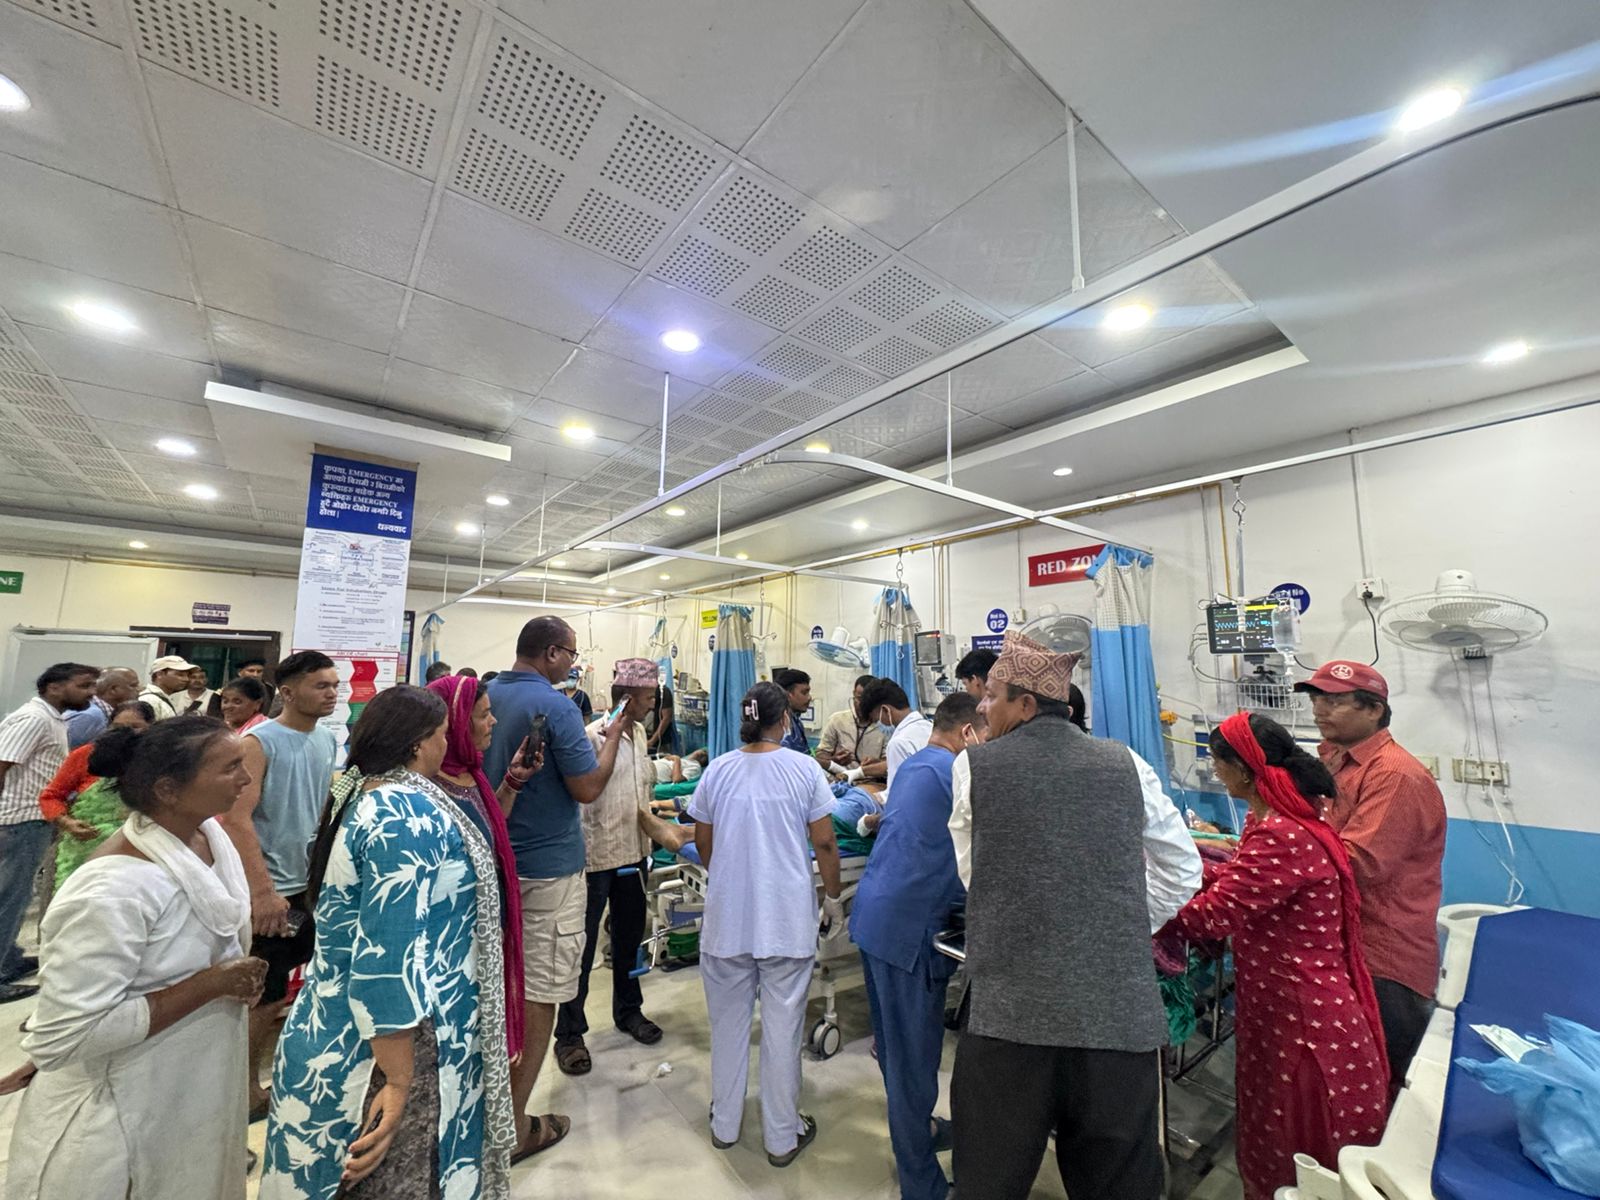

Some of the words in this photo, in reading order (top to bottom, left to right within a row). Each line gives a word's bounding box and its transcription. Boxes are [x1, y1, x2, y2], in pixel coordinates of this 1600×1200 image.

[348, 468, 393, 482] EMERGENCY
[353, 496, 398, 508] EMERGENCY
[377, 522, 407, 533] धन्यवाद
[1037, 560, 1066, 576] RED
[990, 620, 1005, 629] 02
[492, 1096, 512, 1149] TODAY
